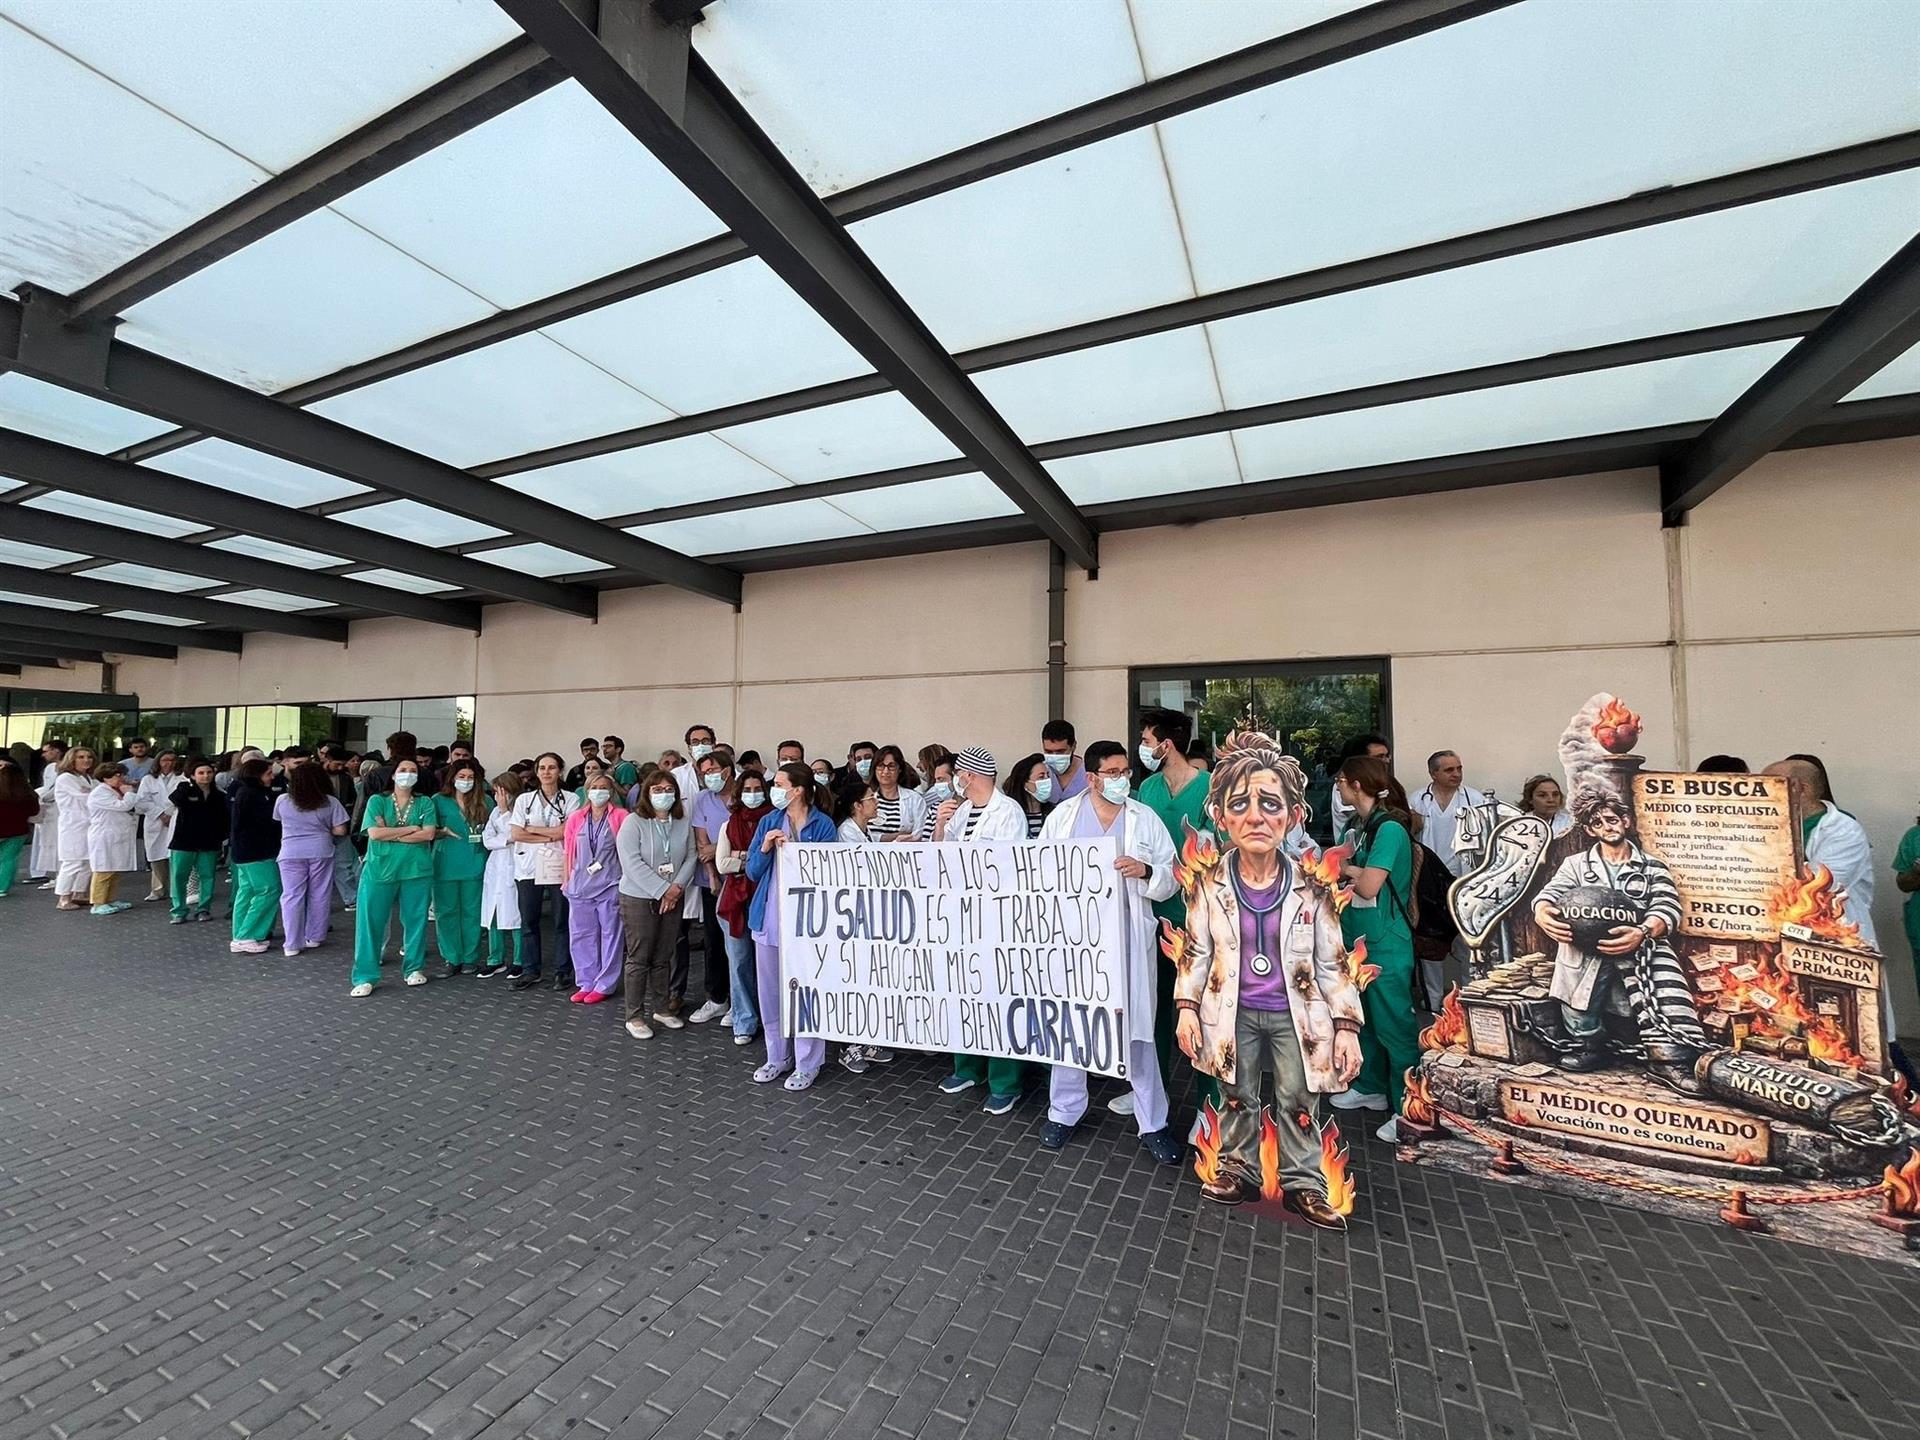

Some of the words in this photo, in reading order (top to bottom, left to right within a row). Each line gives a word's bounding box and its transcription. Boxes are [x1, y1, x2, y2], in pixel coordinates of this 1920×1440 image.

[1645, 779, 1675, 794] SE
[1684, 780, 1769, 797] BUSCA
[1696, 804, 1779, 816] ESPECIALISTA
[1517, 822, 1541, 838] 24
[1690, 820, 1720, 828] 60-100
[1655, 841, 1679, 849] penal
[798, 845, 927, 889] REMITIÉNDOME
[937, 849, 952, 889] A
[959, 847, 1000, 893] LOS
[1504, 872, 1519, 887] 4
[1474, 886, 1503, 904] 24
[788, 887, 829, 939] TU
[926, 893, 950, 944] ES
[992, 894, 1101, 947] TRABAJO
[1561, 904, 1637, 923] VOCACIÓN
[1691, 901, 1766, 917] PRECIO:
[1687, 916, 1704, 929] 18
[815, 943, 828, 979] Y
[840, 940, 857, 984] SI
[946, 948, 982, 995] MIS
[994, 947, 1110, 1002] DERECHOS
[1792, 959, 1871, 984] PRIMARIA
[825, 991, 880, 1039] PUEDO
[885, 994, 950, 1048] HACERLO
[1007, 997, 1127, 1077] CARAJO!
[1726, 1057, 1832, 1095] ESTATUTO
[1730, 1072, 1811, 1110] MARCO
[1509, 1086, 1534, 1104] EL
[1540, 1088, 1628, 1119] MÉDICO
[1633, 1107, 1758, 1140] QUEMADO
[1536, 1109, 1605, 1131] Vocación
[1610, 1123, 1629, 1136] no
[1633, 1127, 1651, 1139] es
[1654, 1129, 1726, 1152] condena
